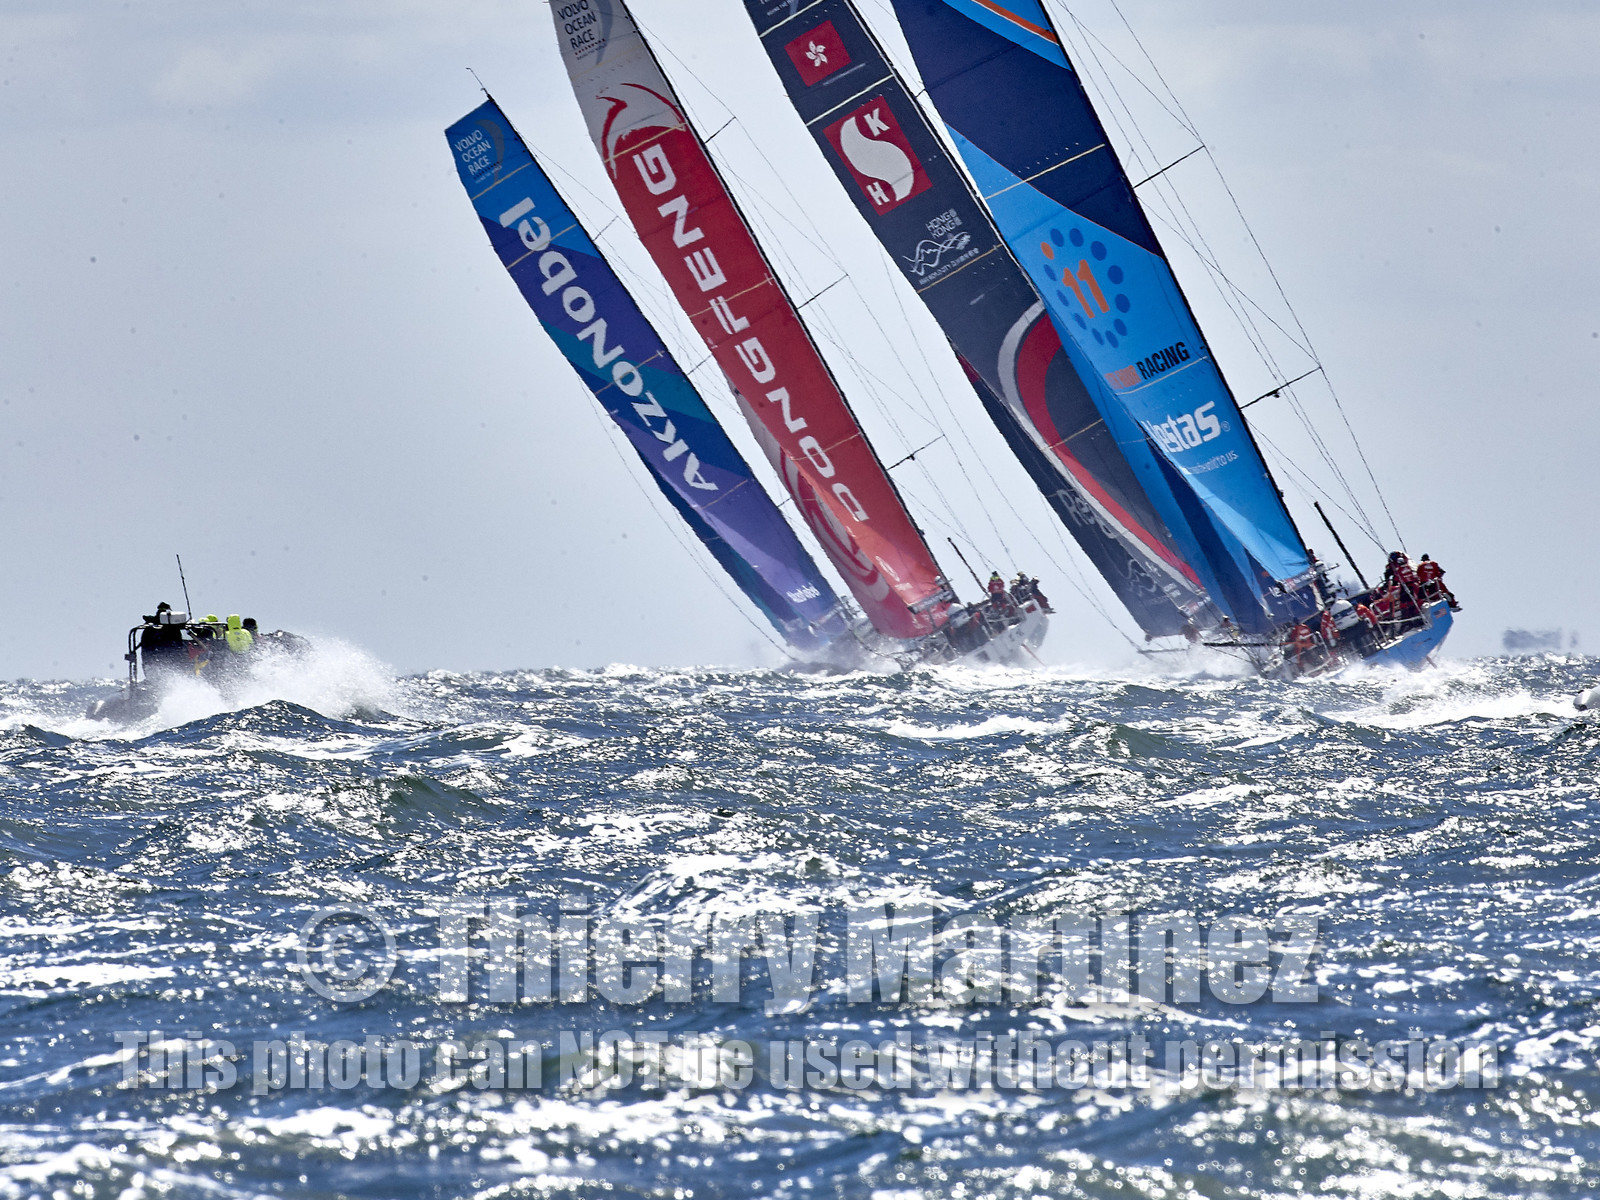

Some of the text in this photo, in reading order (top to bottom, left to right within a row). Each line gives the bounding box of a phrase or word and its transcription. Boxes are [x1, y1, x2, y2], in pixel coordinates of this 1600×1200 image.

[564, 11, 597, 35] OCEAN
[570, 29, 595, 50] RACE
[454, 130, 483, 151] VOLVO
[462, 140, 491, 162] OCEAN
[467, 155, 489, 175] RACE
[925, 211, 951, 232] HONG
[930, 219, 956, 239] KONG
[1061, 259, 1110, 319] 11
[633, 144, 869, 522] DONGFENG
[1136, 341, 1190, 380] RACING
[1141, 401, 1220, 453] Vestas
